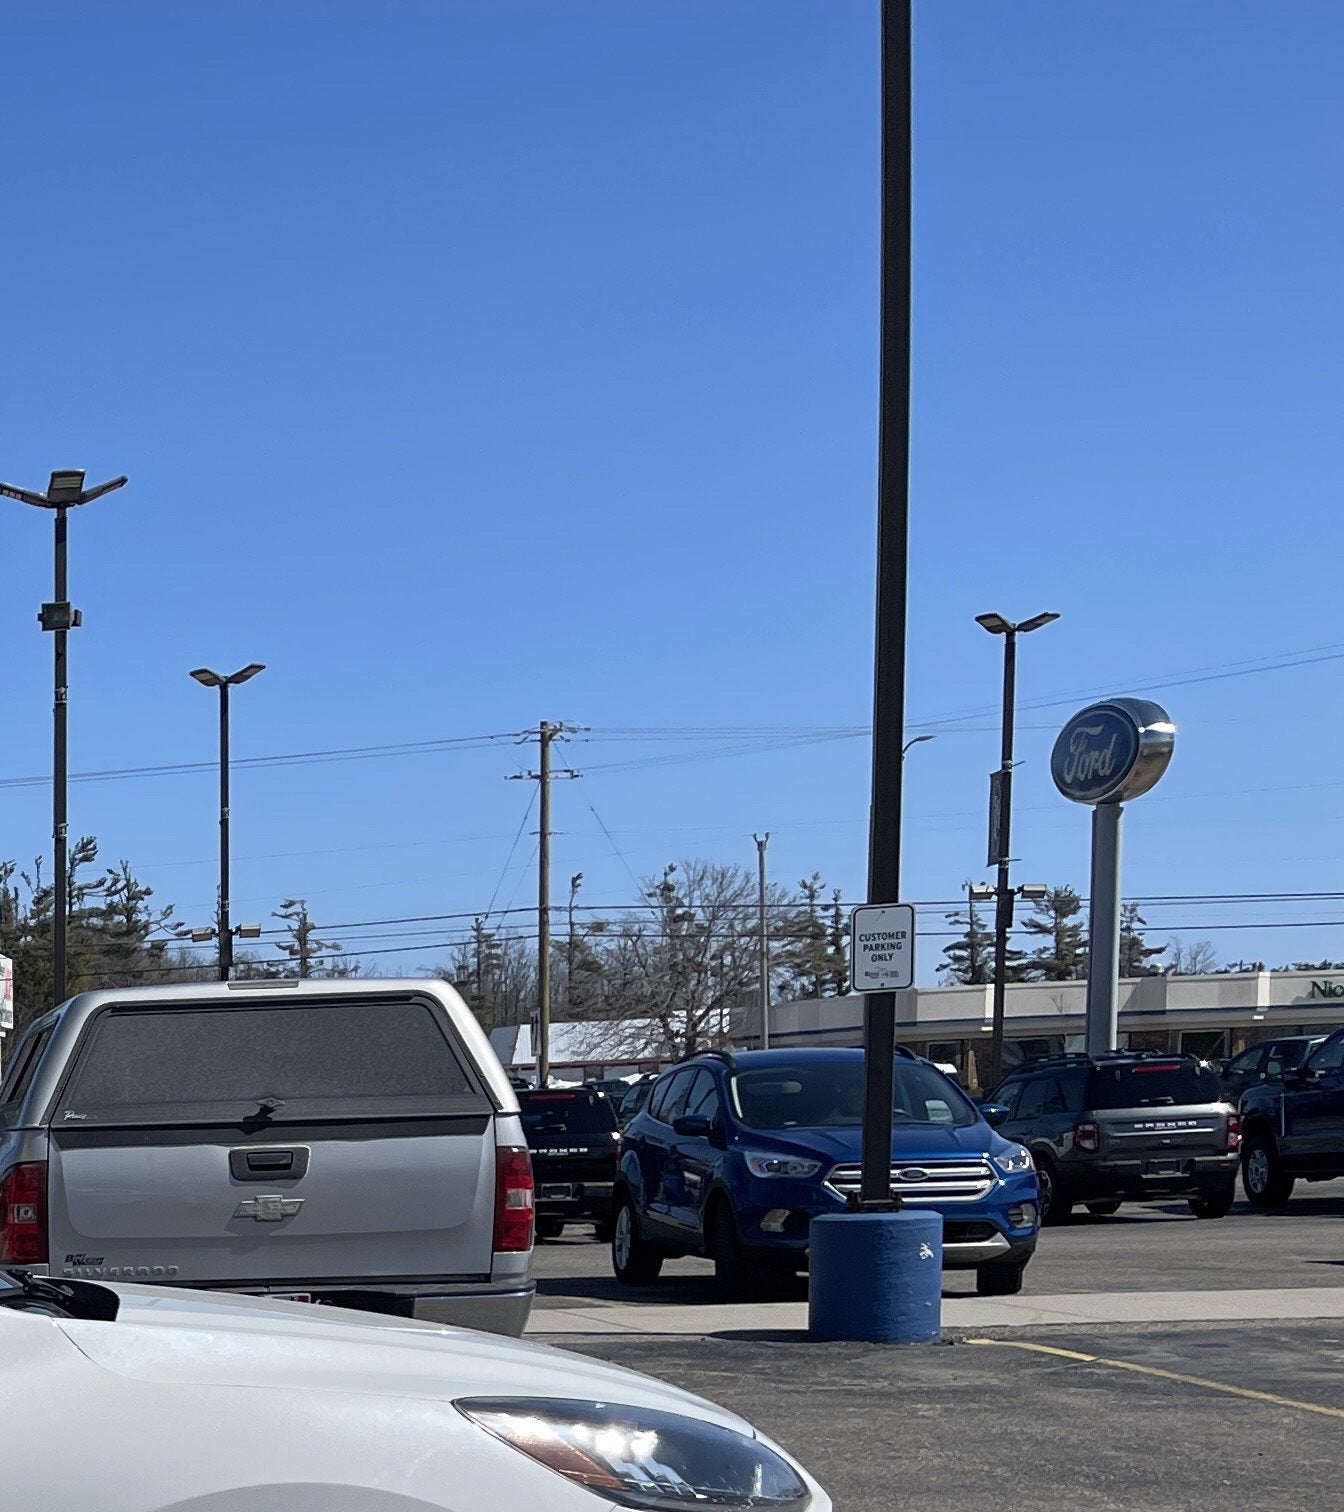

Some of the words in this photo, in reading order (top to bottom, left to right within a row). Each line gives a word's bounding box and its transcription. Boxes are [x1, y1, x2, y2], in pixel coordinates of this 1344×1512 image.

[1063, 723, 1118, 784] Ford
[859, 931, 907, 942] CUSTOMER
[863, 942, 902, 952] PARKING
[871, 953, 894, 962] ONLY
